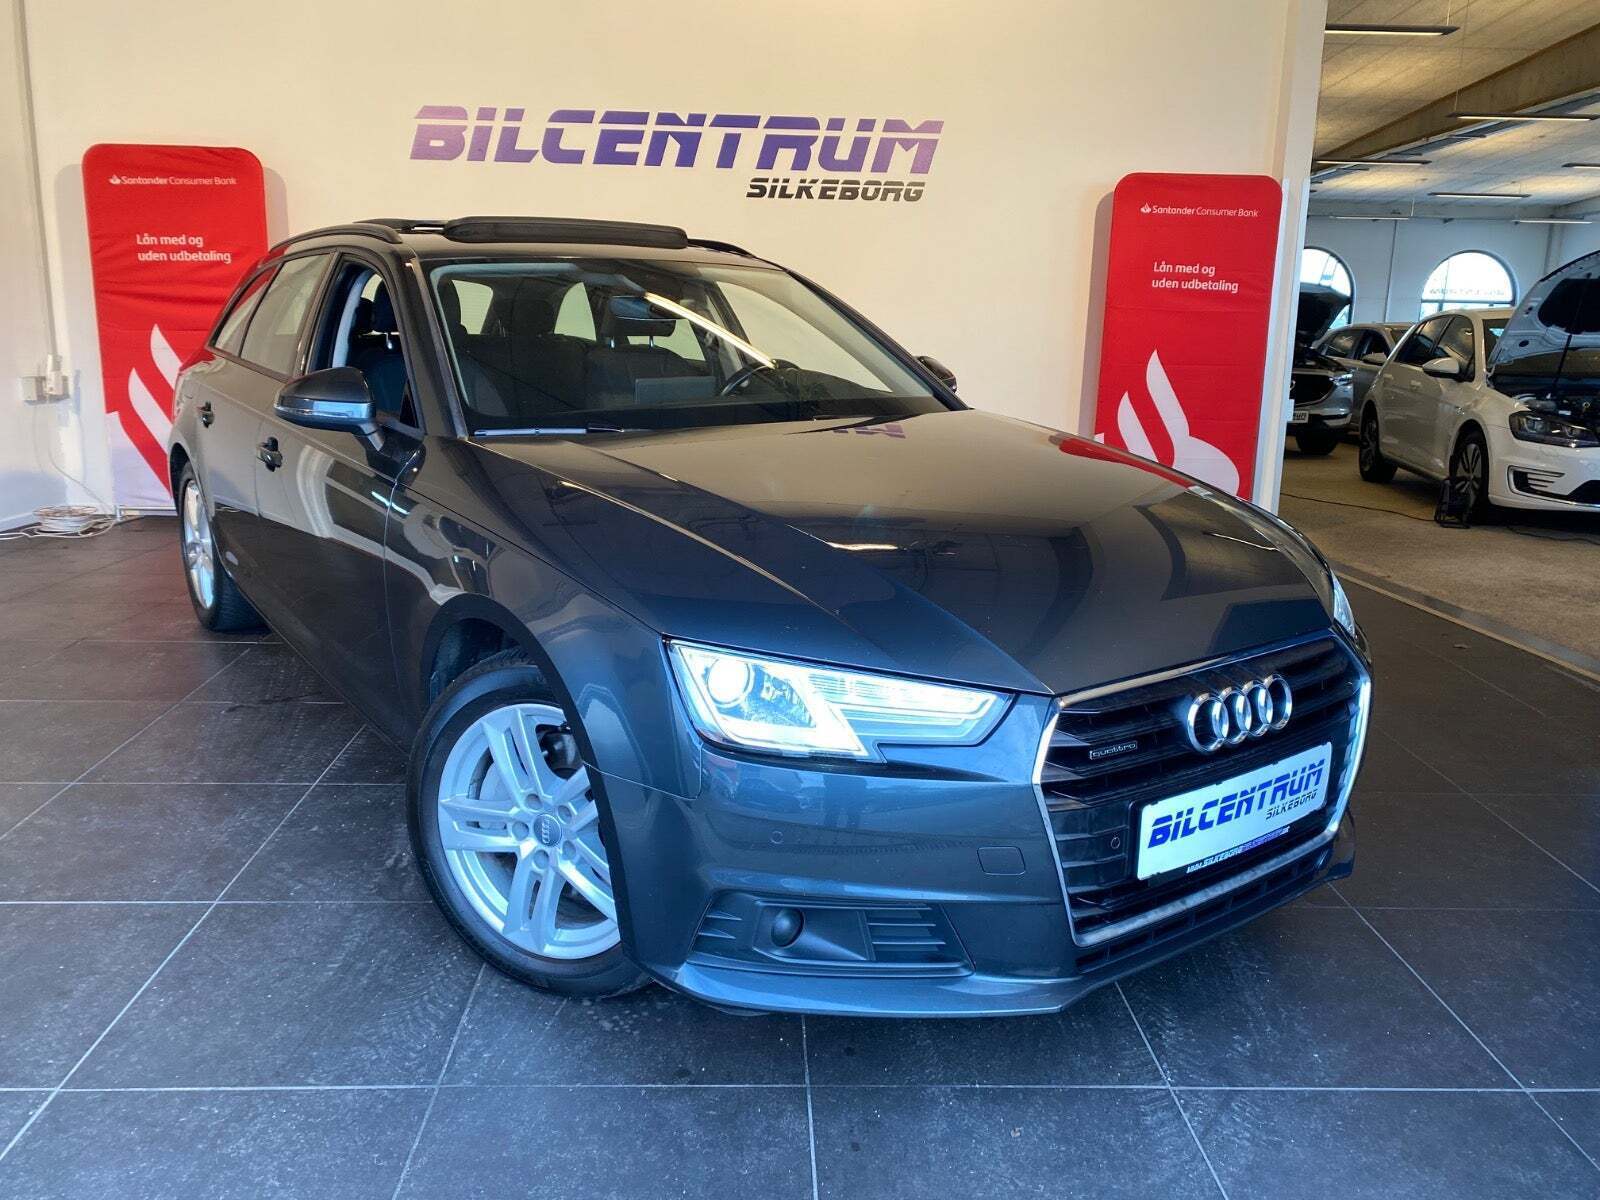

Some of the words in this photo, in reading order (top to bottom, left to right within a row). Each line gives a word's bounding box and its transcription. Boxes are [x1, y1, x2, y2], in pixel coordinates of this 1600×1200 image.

[409, 105, 945, 175] BILCENTRUM
[121, 175, 168, 185] Santander
[169, 176, 213, 185] Consumer
[214, 177, 237, 185] Bank
[745, 177, 927, 203] SILKEBORG
[1152, 205, 1195, 215] Santander
[1196, 207, 1237, 217] Consumer
[1238, 208, 1259, 218] Bank
[136, 233, 158, 245] Lån
[160, 234, 187, 245] med
[188, 236, 204, 248] og
[137, 250, 168, 262] uden
[169, 250, 232, 264] udbetaling
[1153, 261, 1173, 273] Lån
[1175, 263, 1200, 274] med
[1201, 265, 1216, 277] og
[1152, 278, 1179, 289] uden
[1181, 279, 1239, 294] udbetaling
[1092, 743, 1136, 757] quattro
[1147, 758, 1326, 849] BILCENTRUM
[1265, 789, 1319, 820] SILKEBORG
